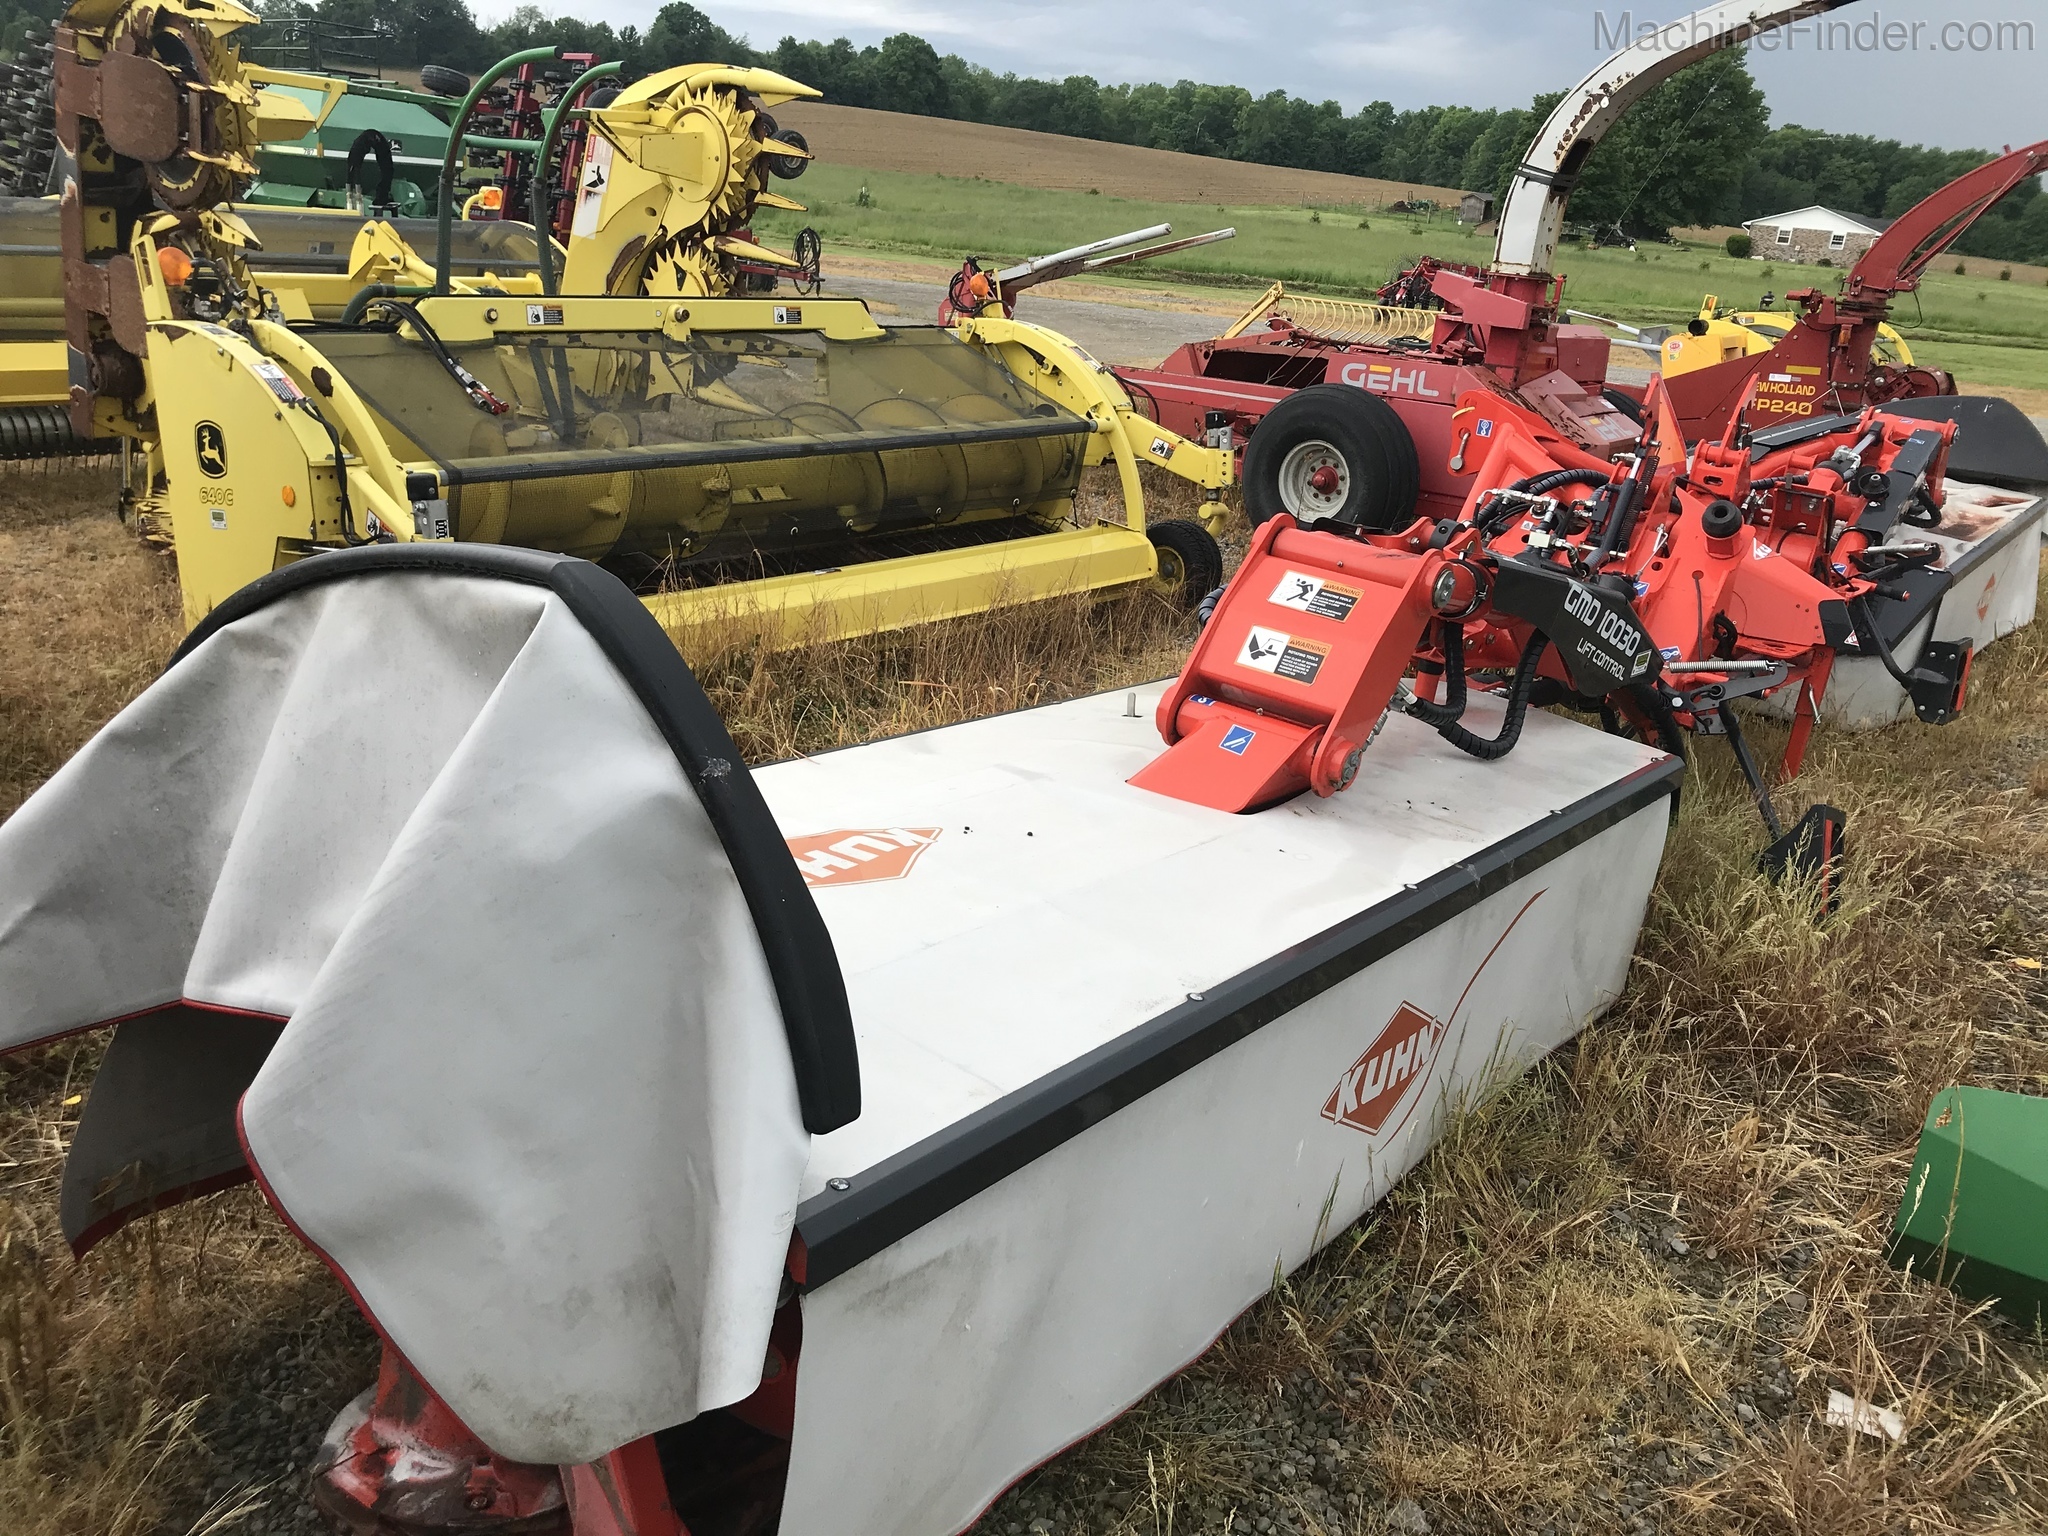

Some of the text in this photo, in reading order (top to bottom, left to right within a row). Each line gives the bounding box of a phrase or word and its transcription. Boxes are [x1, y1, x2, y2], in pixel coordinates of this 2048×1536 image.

[1341, 362, 1440, 397] GEHL
[1769, 383, 1816, 396] HOLLAND
[199, 486, 234, 506] 640C
[1329, 584, 1360, 597] WARNING
[1564, 584, 1641, 657] GMD 10030
[1295, 640, 1327, 653] WARNING
[1576, 637, 1625, 681] LIFT CONTROL
[794, 827, 938, 883] KUH
[1333, 1016, 1437, 1124] KUHN
